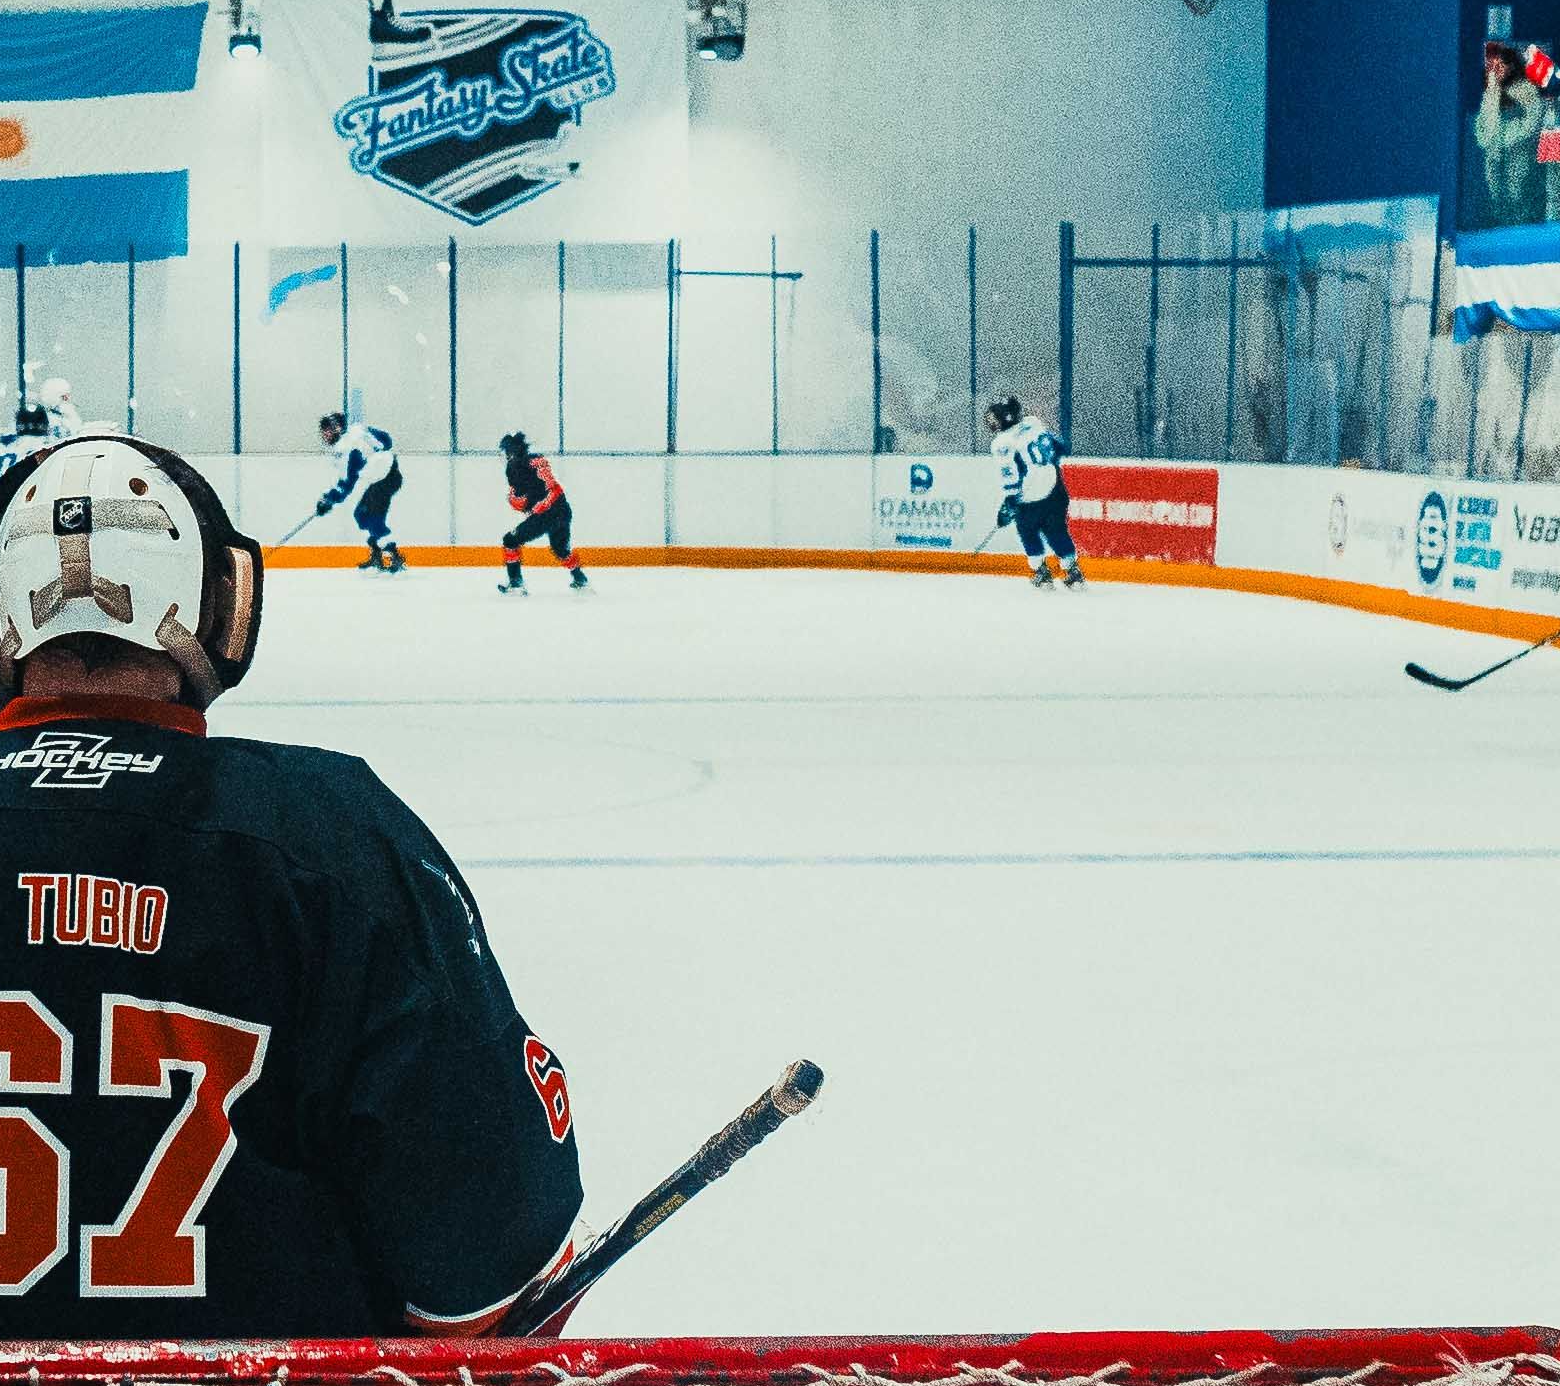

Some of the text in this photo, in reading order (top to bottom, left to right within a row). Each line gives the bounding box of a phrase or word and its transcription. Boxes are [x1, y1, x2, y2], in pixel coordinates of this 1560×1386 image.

[340, 27, 607, 168] Fantasy Skate
[18, 872, 169, 956] TUBIO
